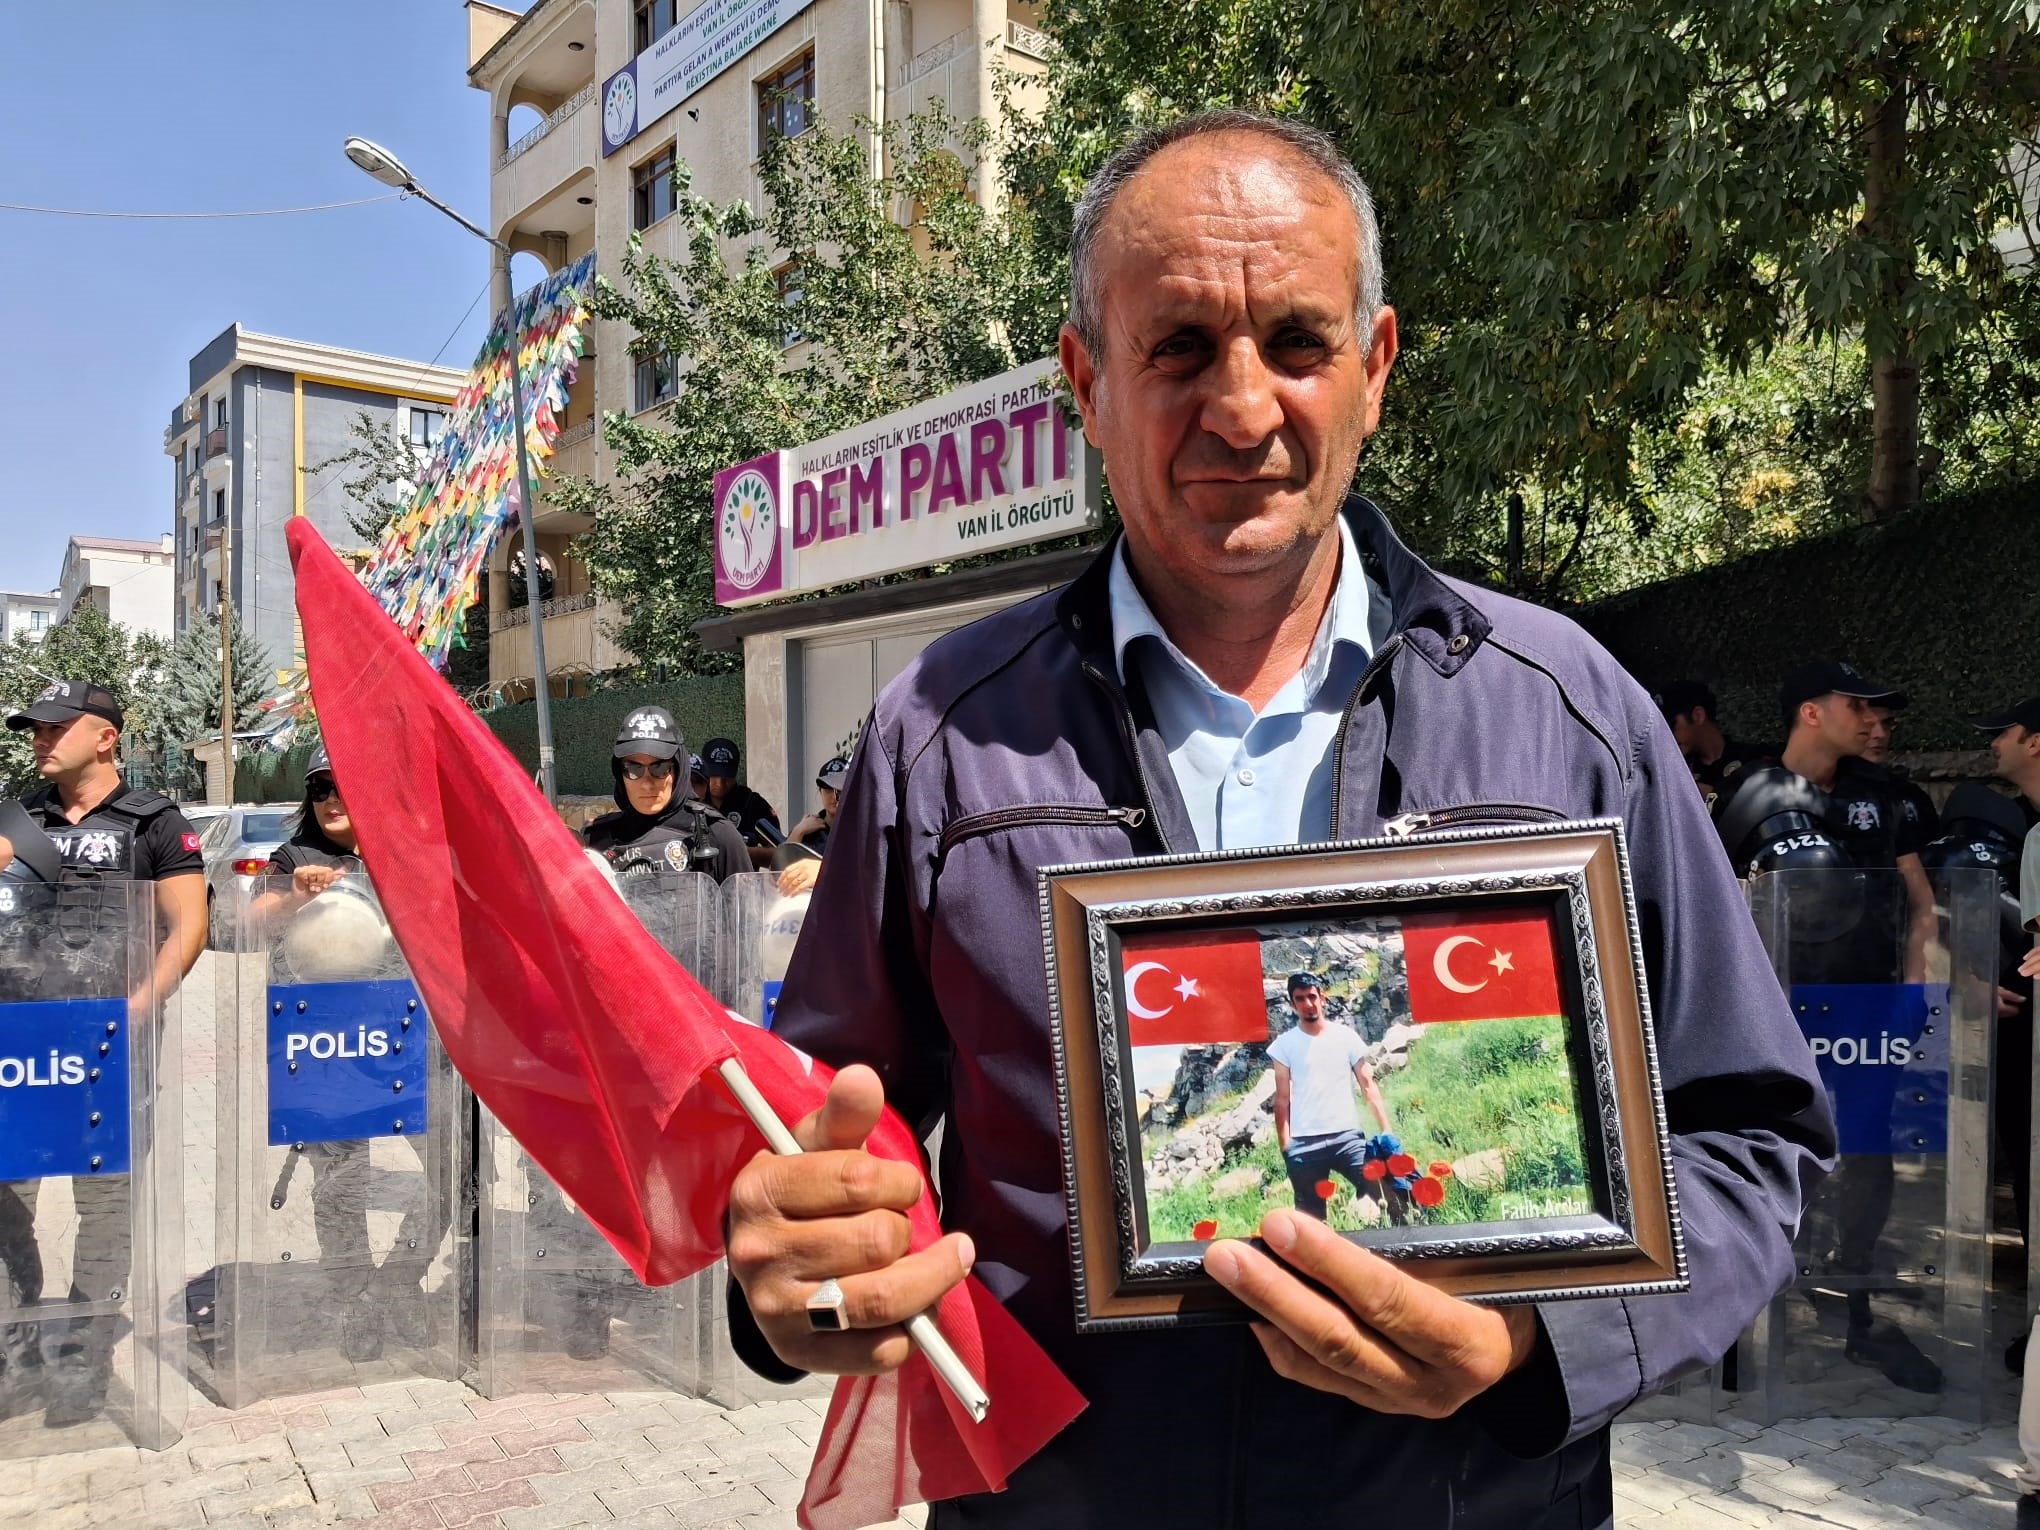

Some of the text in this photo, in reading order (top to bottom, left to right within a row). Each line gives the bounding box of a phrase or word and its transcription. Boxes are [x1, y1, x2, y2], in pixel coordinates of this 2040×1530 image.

[703, 18, 718, 38] VAN
[684, 51, 706, 77] GELAN
[802, 444, 860, 477] HALKLARIN
[862, 427, 904, 459] EŞİTLİK
[907, 423, 921, 444] VE
[924, 393, 996, 437] DEMOKRASİ
[793, 455, 883, 550] DEM
[958, 490, 1074, 540] VAN İL ÖRGÜTÜ
[1773, 834, 1830, 855] T213
[287, 1026, 388, 1060] POLİS
[1810, 1031, 1911, 1065] POLİS
